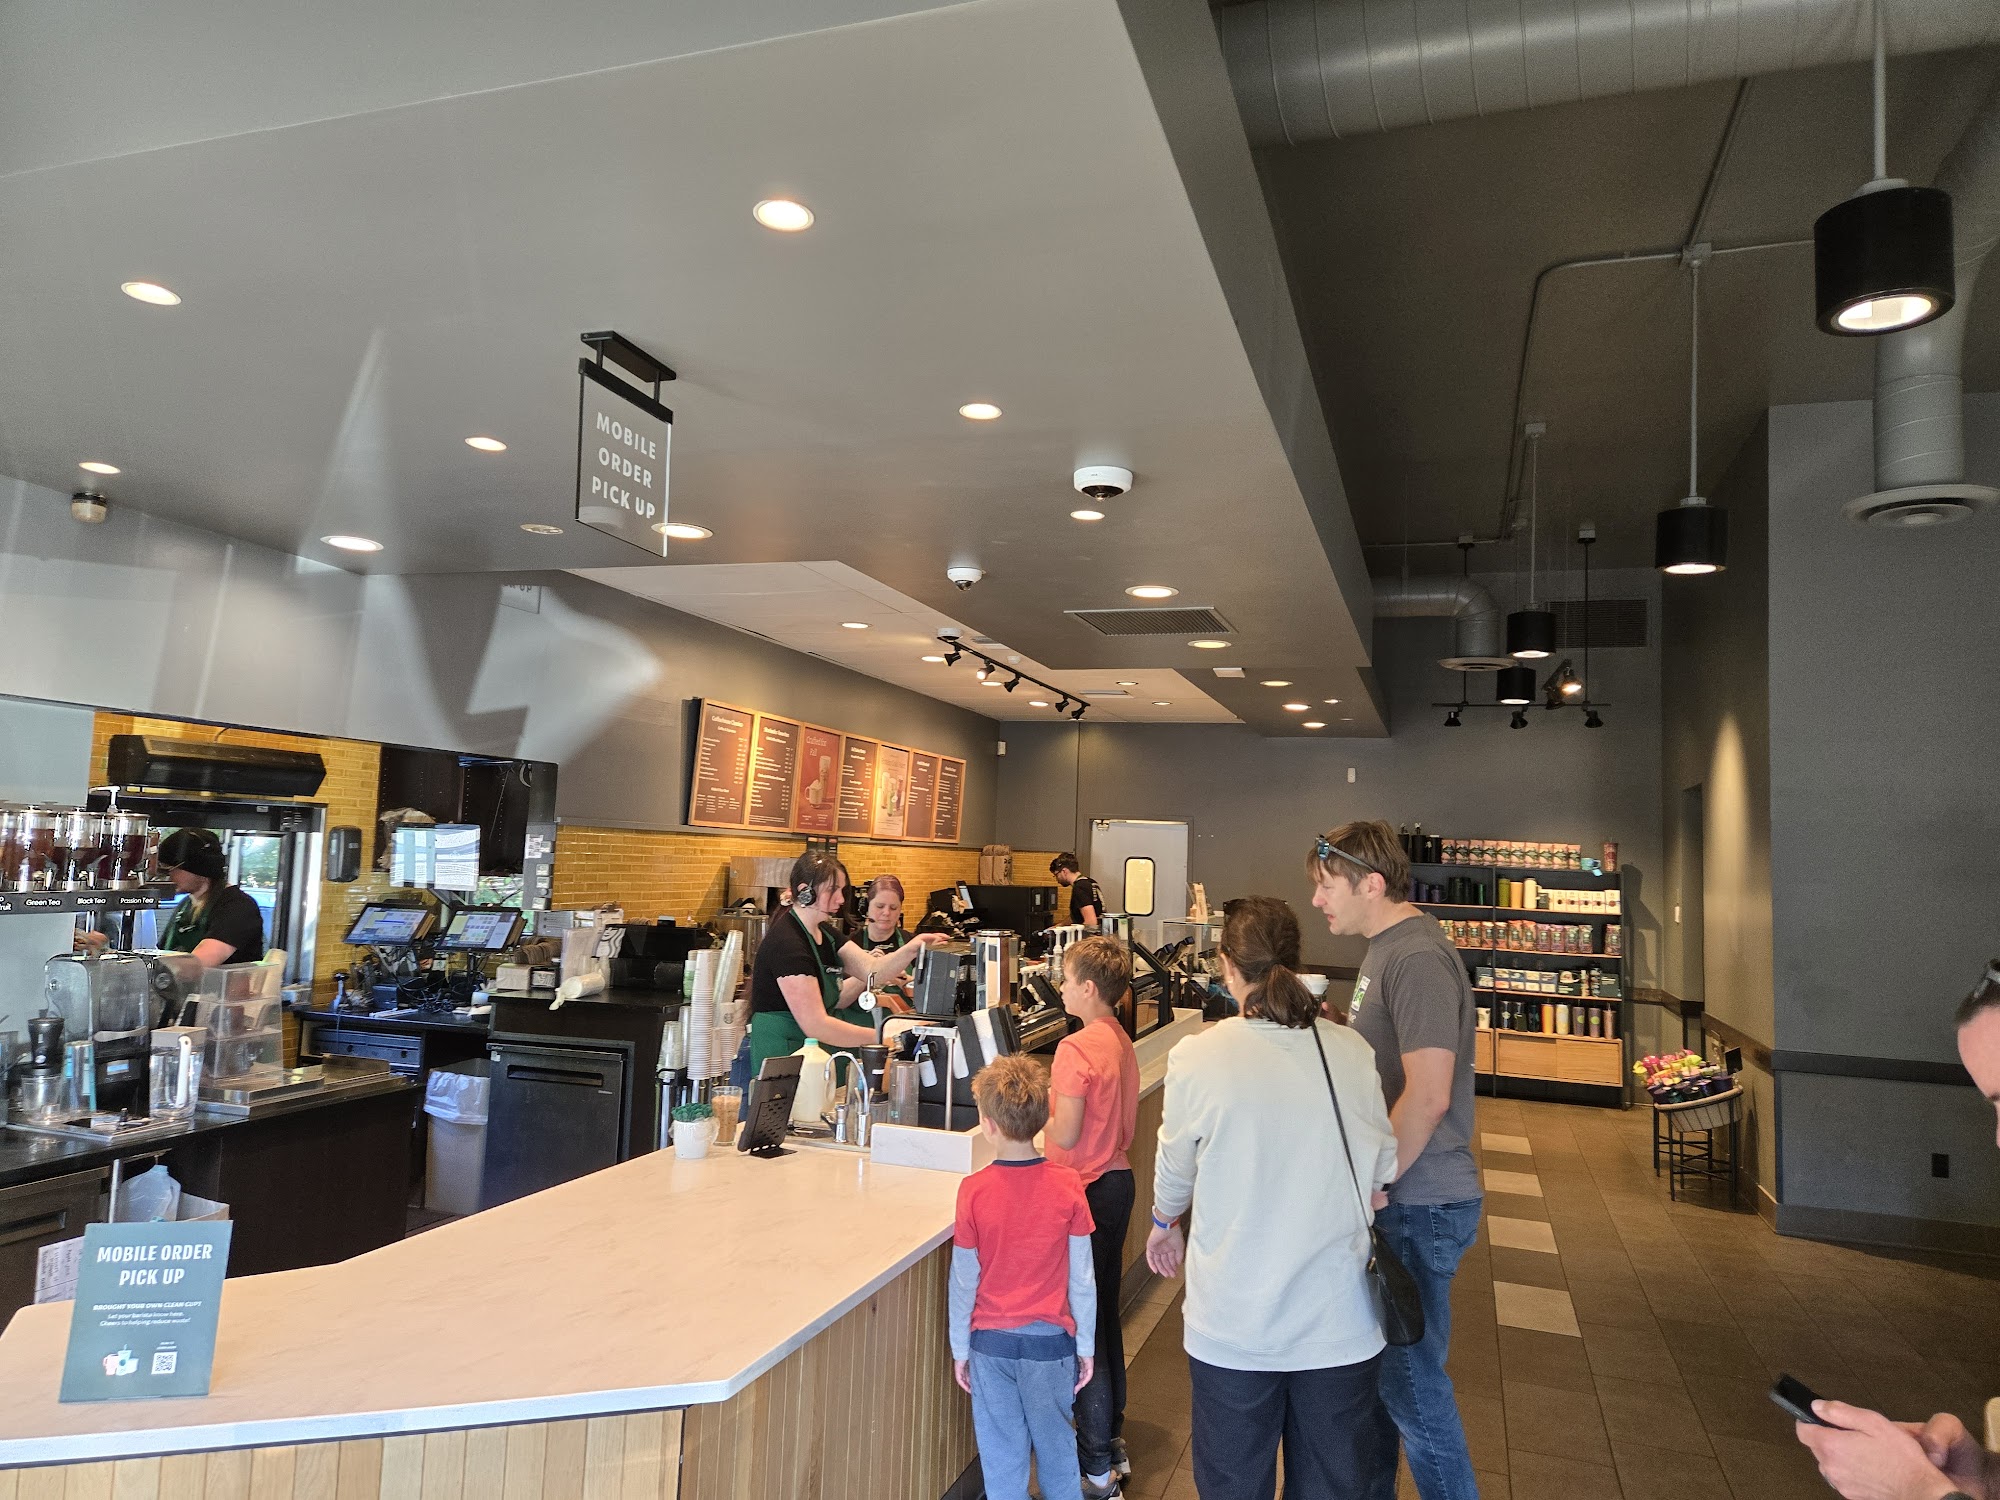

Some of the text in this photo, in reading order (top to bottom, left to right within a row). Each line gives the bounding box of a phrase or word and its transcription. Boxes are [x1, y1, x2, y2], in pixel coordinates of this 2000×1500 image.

[597, 412, 656, 460] MOBILE
[599, 447, 652, 489] ORDER
[592, 475, 656, 519] PICK UP
[97, 1243, 213, 1263] MOBILE ORDER
[119, 1268, 185, 1286] PICK UP
[93, 1303, 127, 1311] BROUGHT
